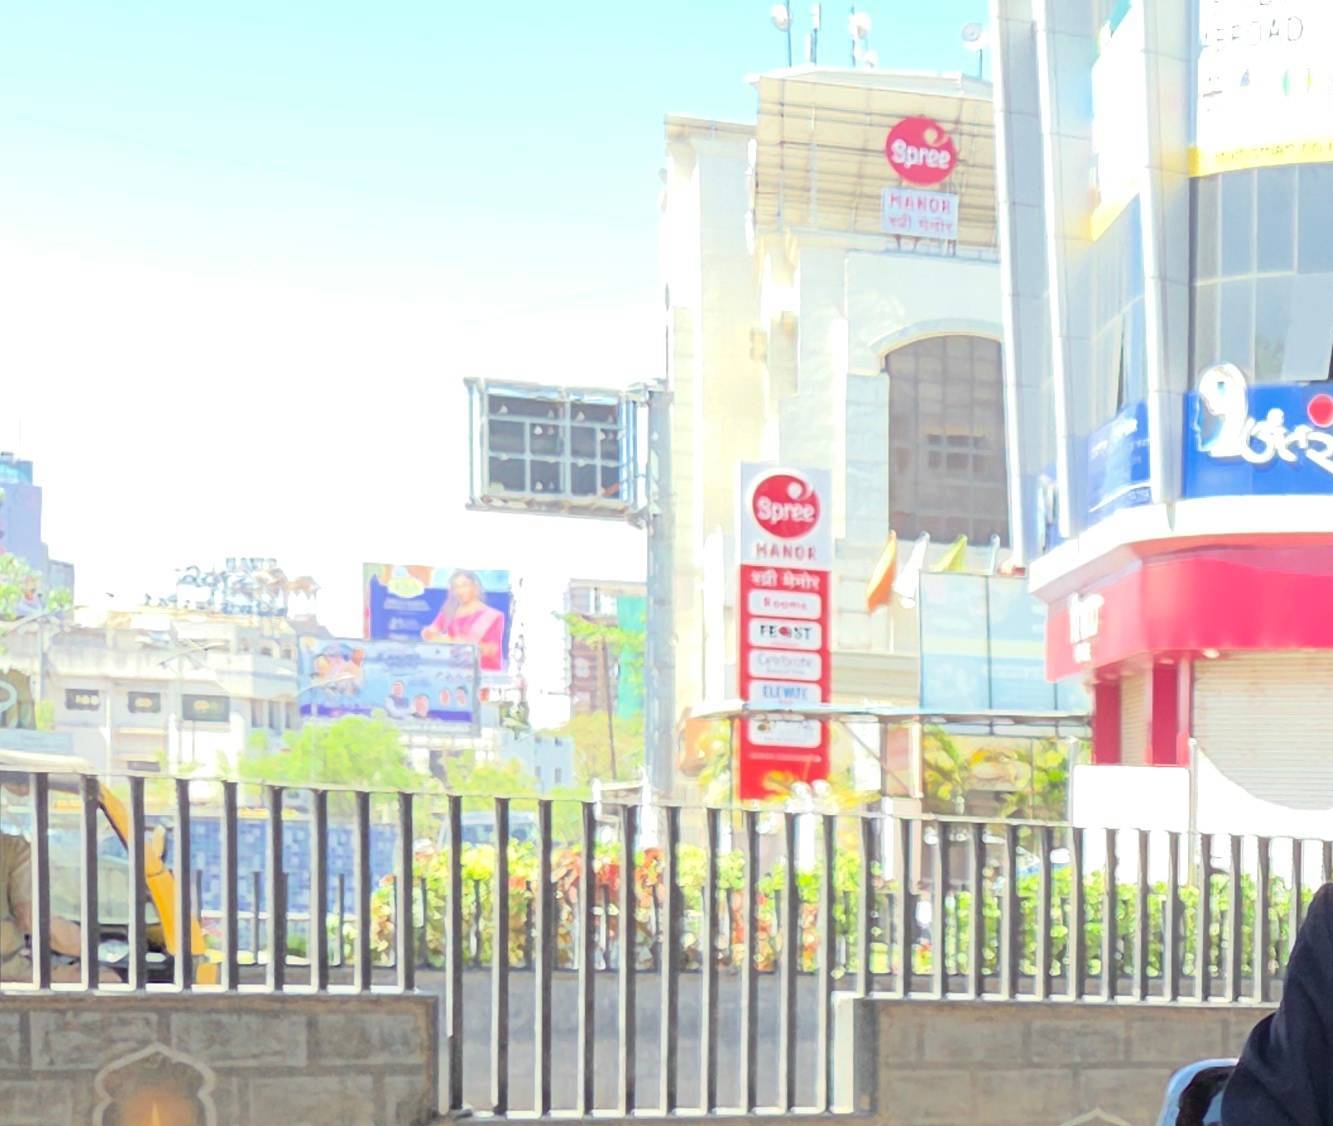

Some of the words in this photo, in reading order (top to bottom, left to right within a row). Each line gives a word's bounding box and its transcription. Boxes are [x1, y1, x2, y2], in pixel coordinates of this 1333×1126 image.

[890, 138, 952, 170] Spree
[889, 193, 951, 215] MANOR
[756, 495, 816, 526] Spree
[755, 543, 817, 562] MANOR
